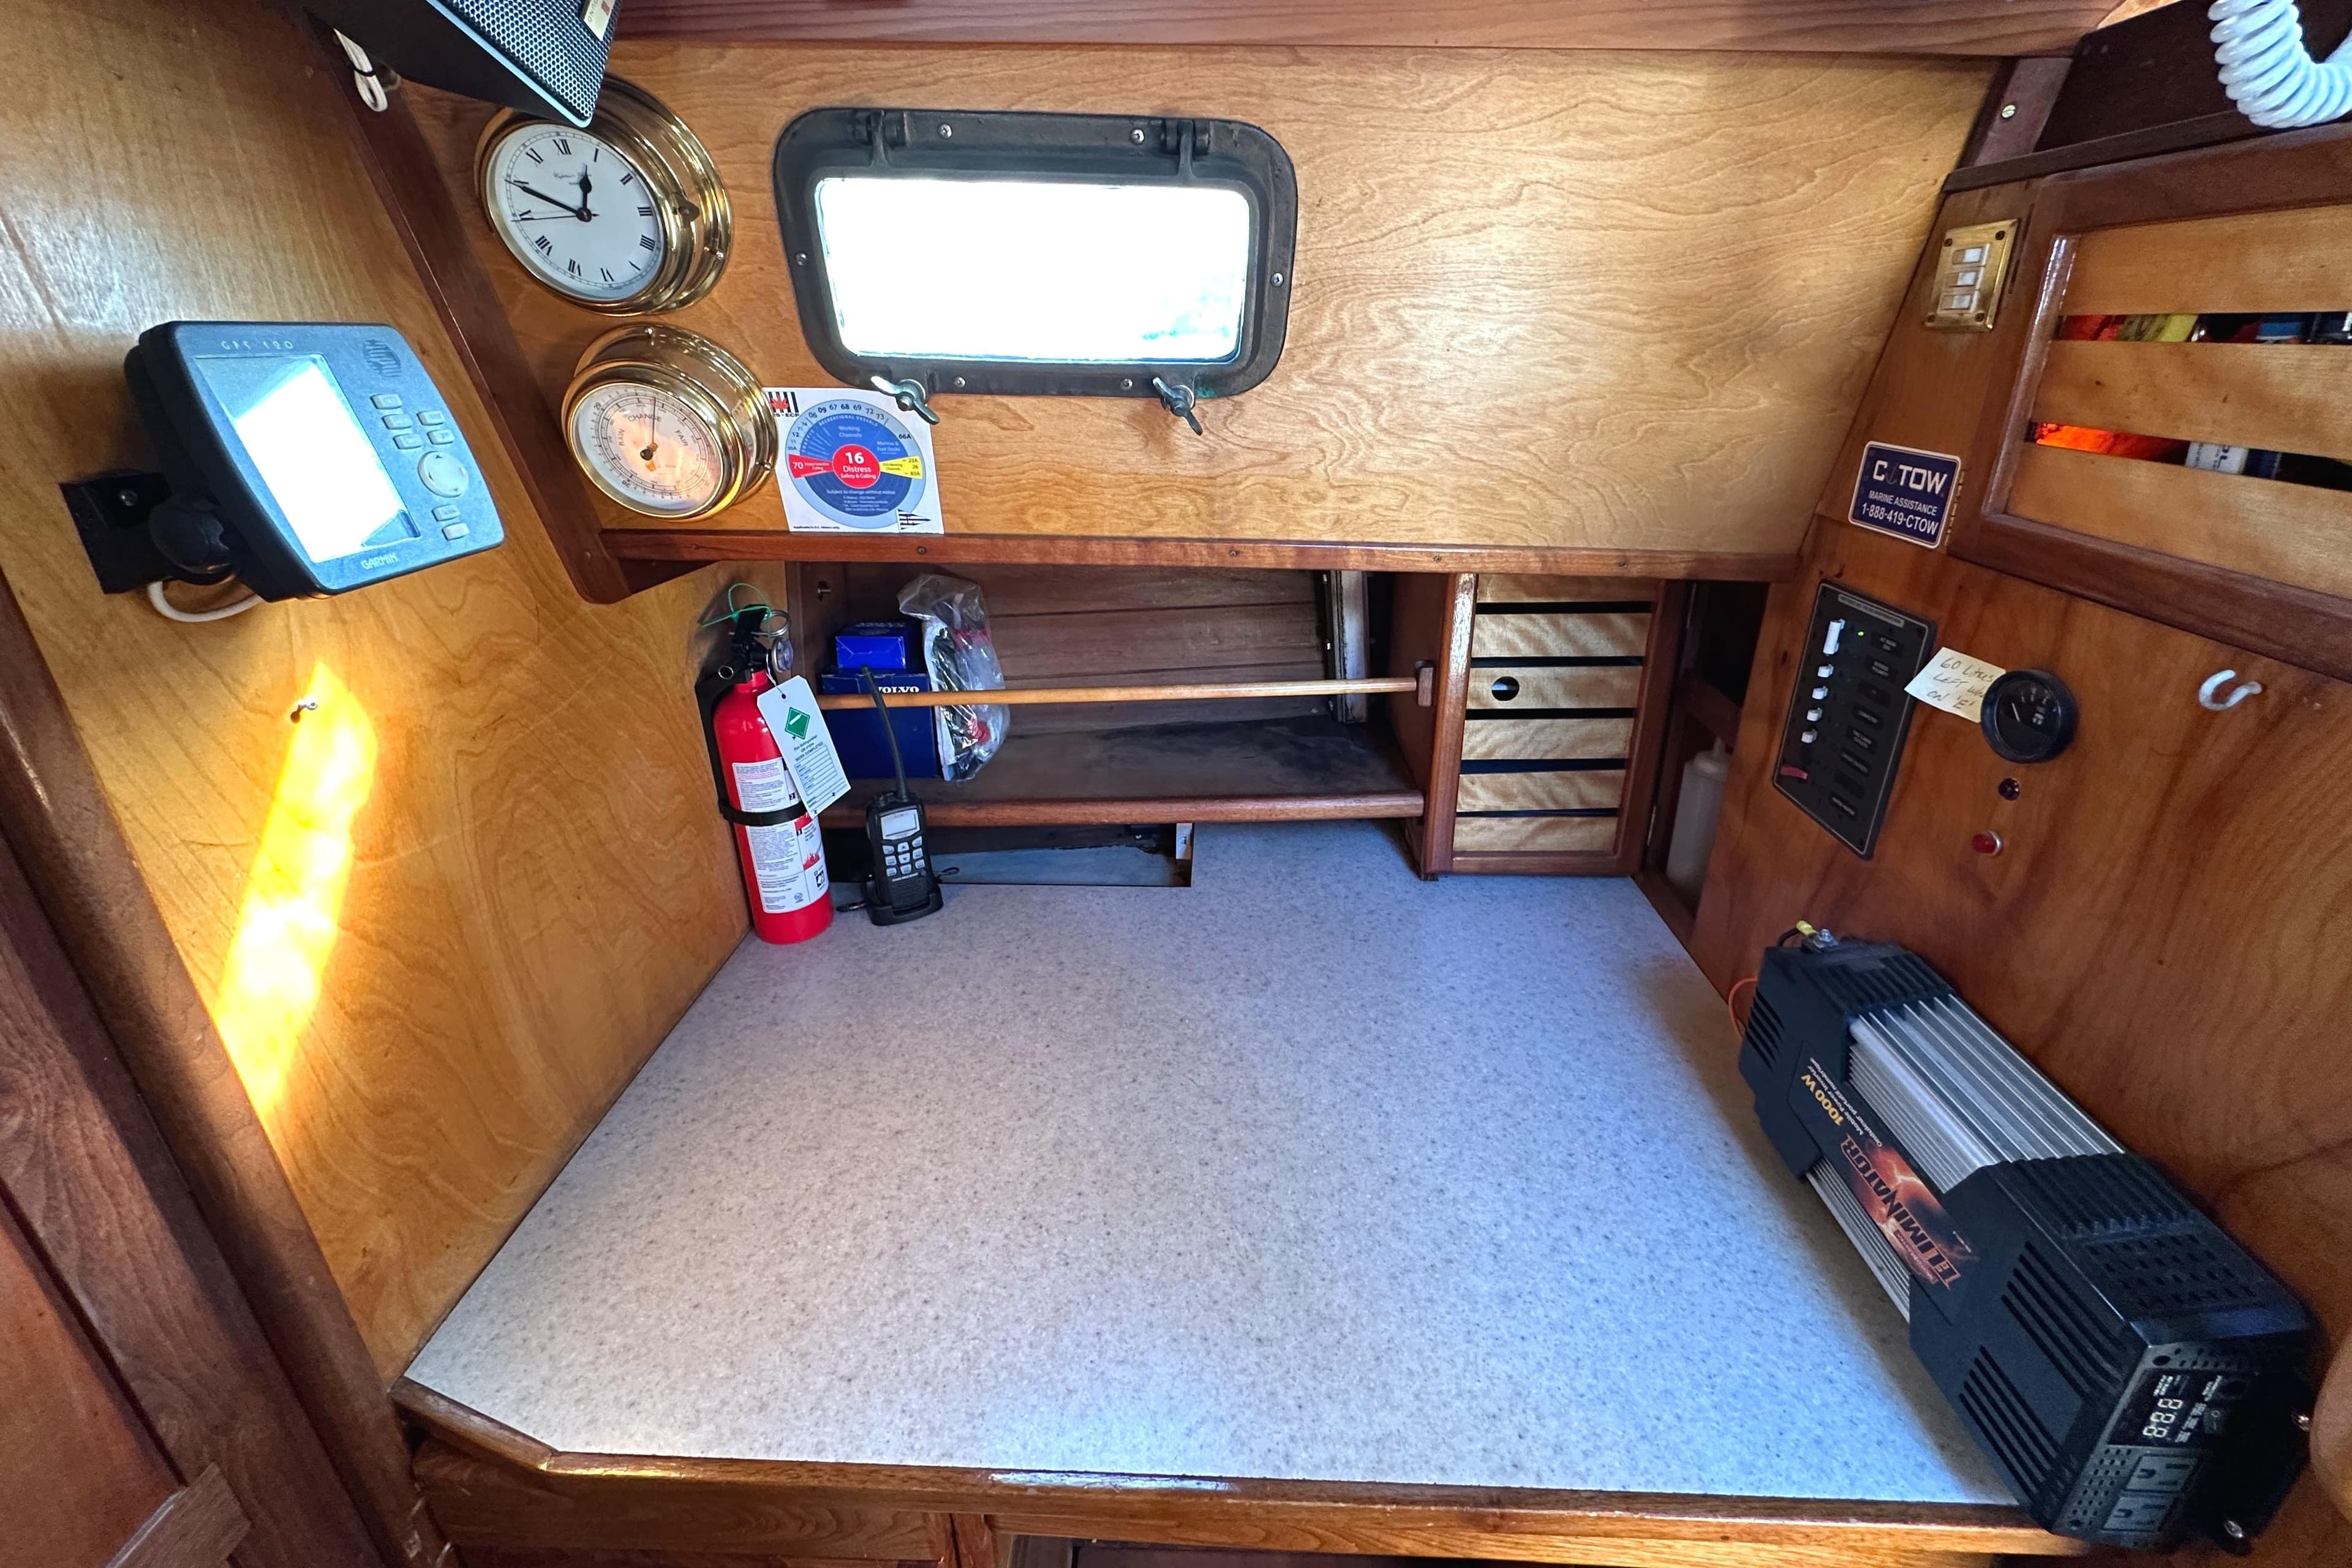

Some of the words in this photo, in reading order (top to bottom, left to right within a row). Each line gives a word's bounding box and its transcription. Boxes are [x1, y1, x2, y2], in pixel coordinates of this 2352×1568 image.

[628, 413, 662, 423] CHANGE
[676, 430, 688, 447] FAIR
[845, 452, 865, 464] 16
[1899, 464, 1947, 495] TOW
[1869, 490, 1894, 505] MARINE
[1894, 497, 1938, 516] ASSISTANCE
[1861, 502, 1939, 535] 1-888-419-CTOW
[360, 552, 399, 570] GARMIN
[1940, 657, 1961, 669] 60
[1932, 673, 1969, 687] LEFT
[1926, 690, 1950, 702] ON
[1801, 1074, 1817, 1091] W
[1807, 1065, 1829, 1091] Inverter
[1814, 1089, 1843, 1126] 1000
[1827, 1091, 1845, 1112] Power
[1843, 1110, 1864, 1136] Mobile
[1855, 1115, 1883, 1147] Onduleur
[1841, 1134, 1961, 1290] ELIMINATOR
